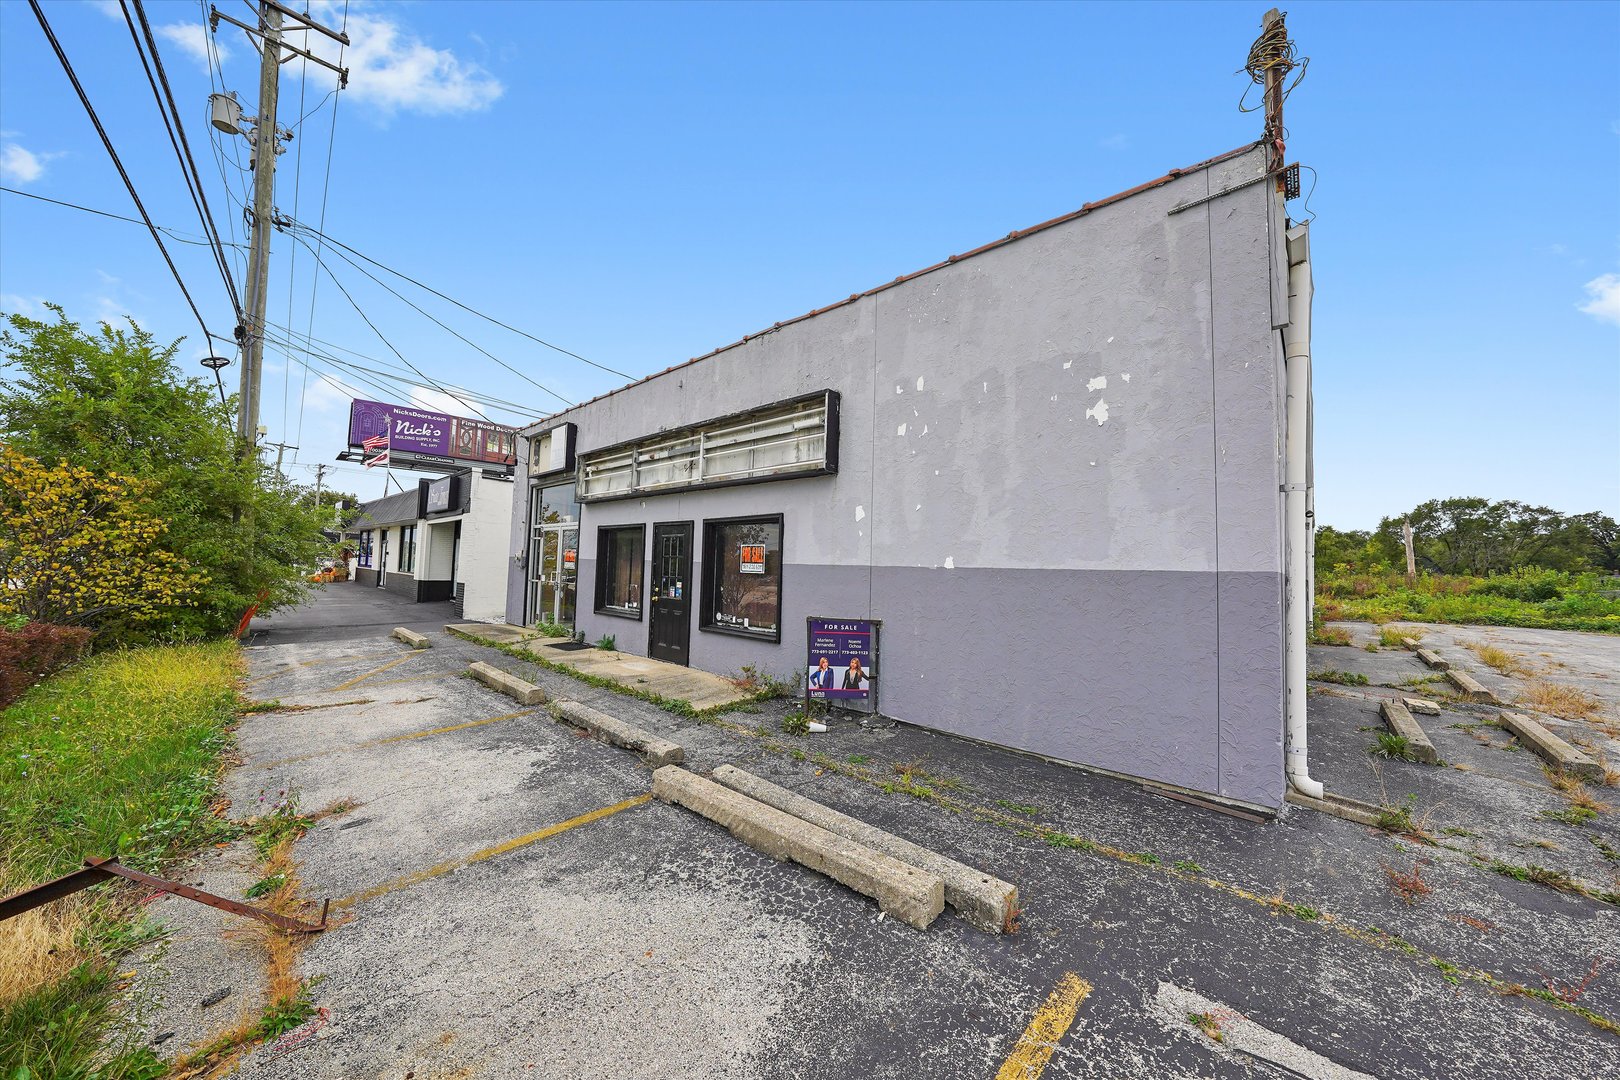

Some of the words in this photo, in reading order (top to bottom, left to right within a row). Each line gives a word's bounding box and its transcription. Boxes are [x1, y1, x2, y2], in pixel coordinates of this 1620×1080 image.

[393, 408, 447, 422] NicksDoors.com
[395, 420, 441, 436] Nick's
[477, 422, 495, 431] Wood
